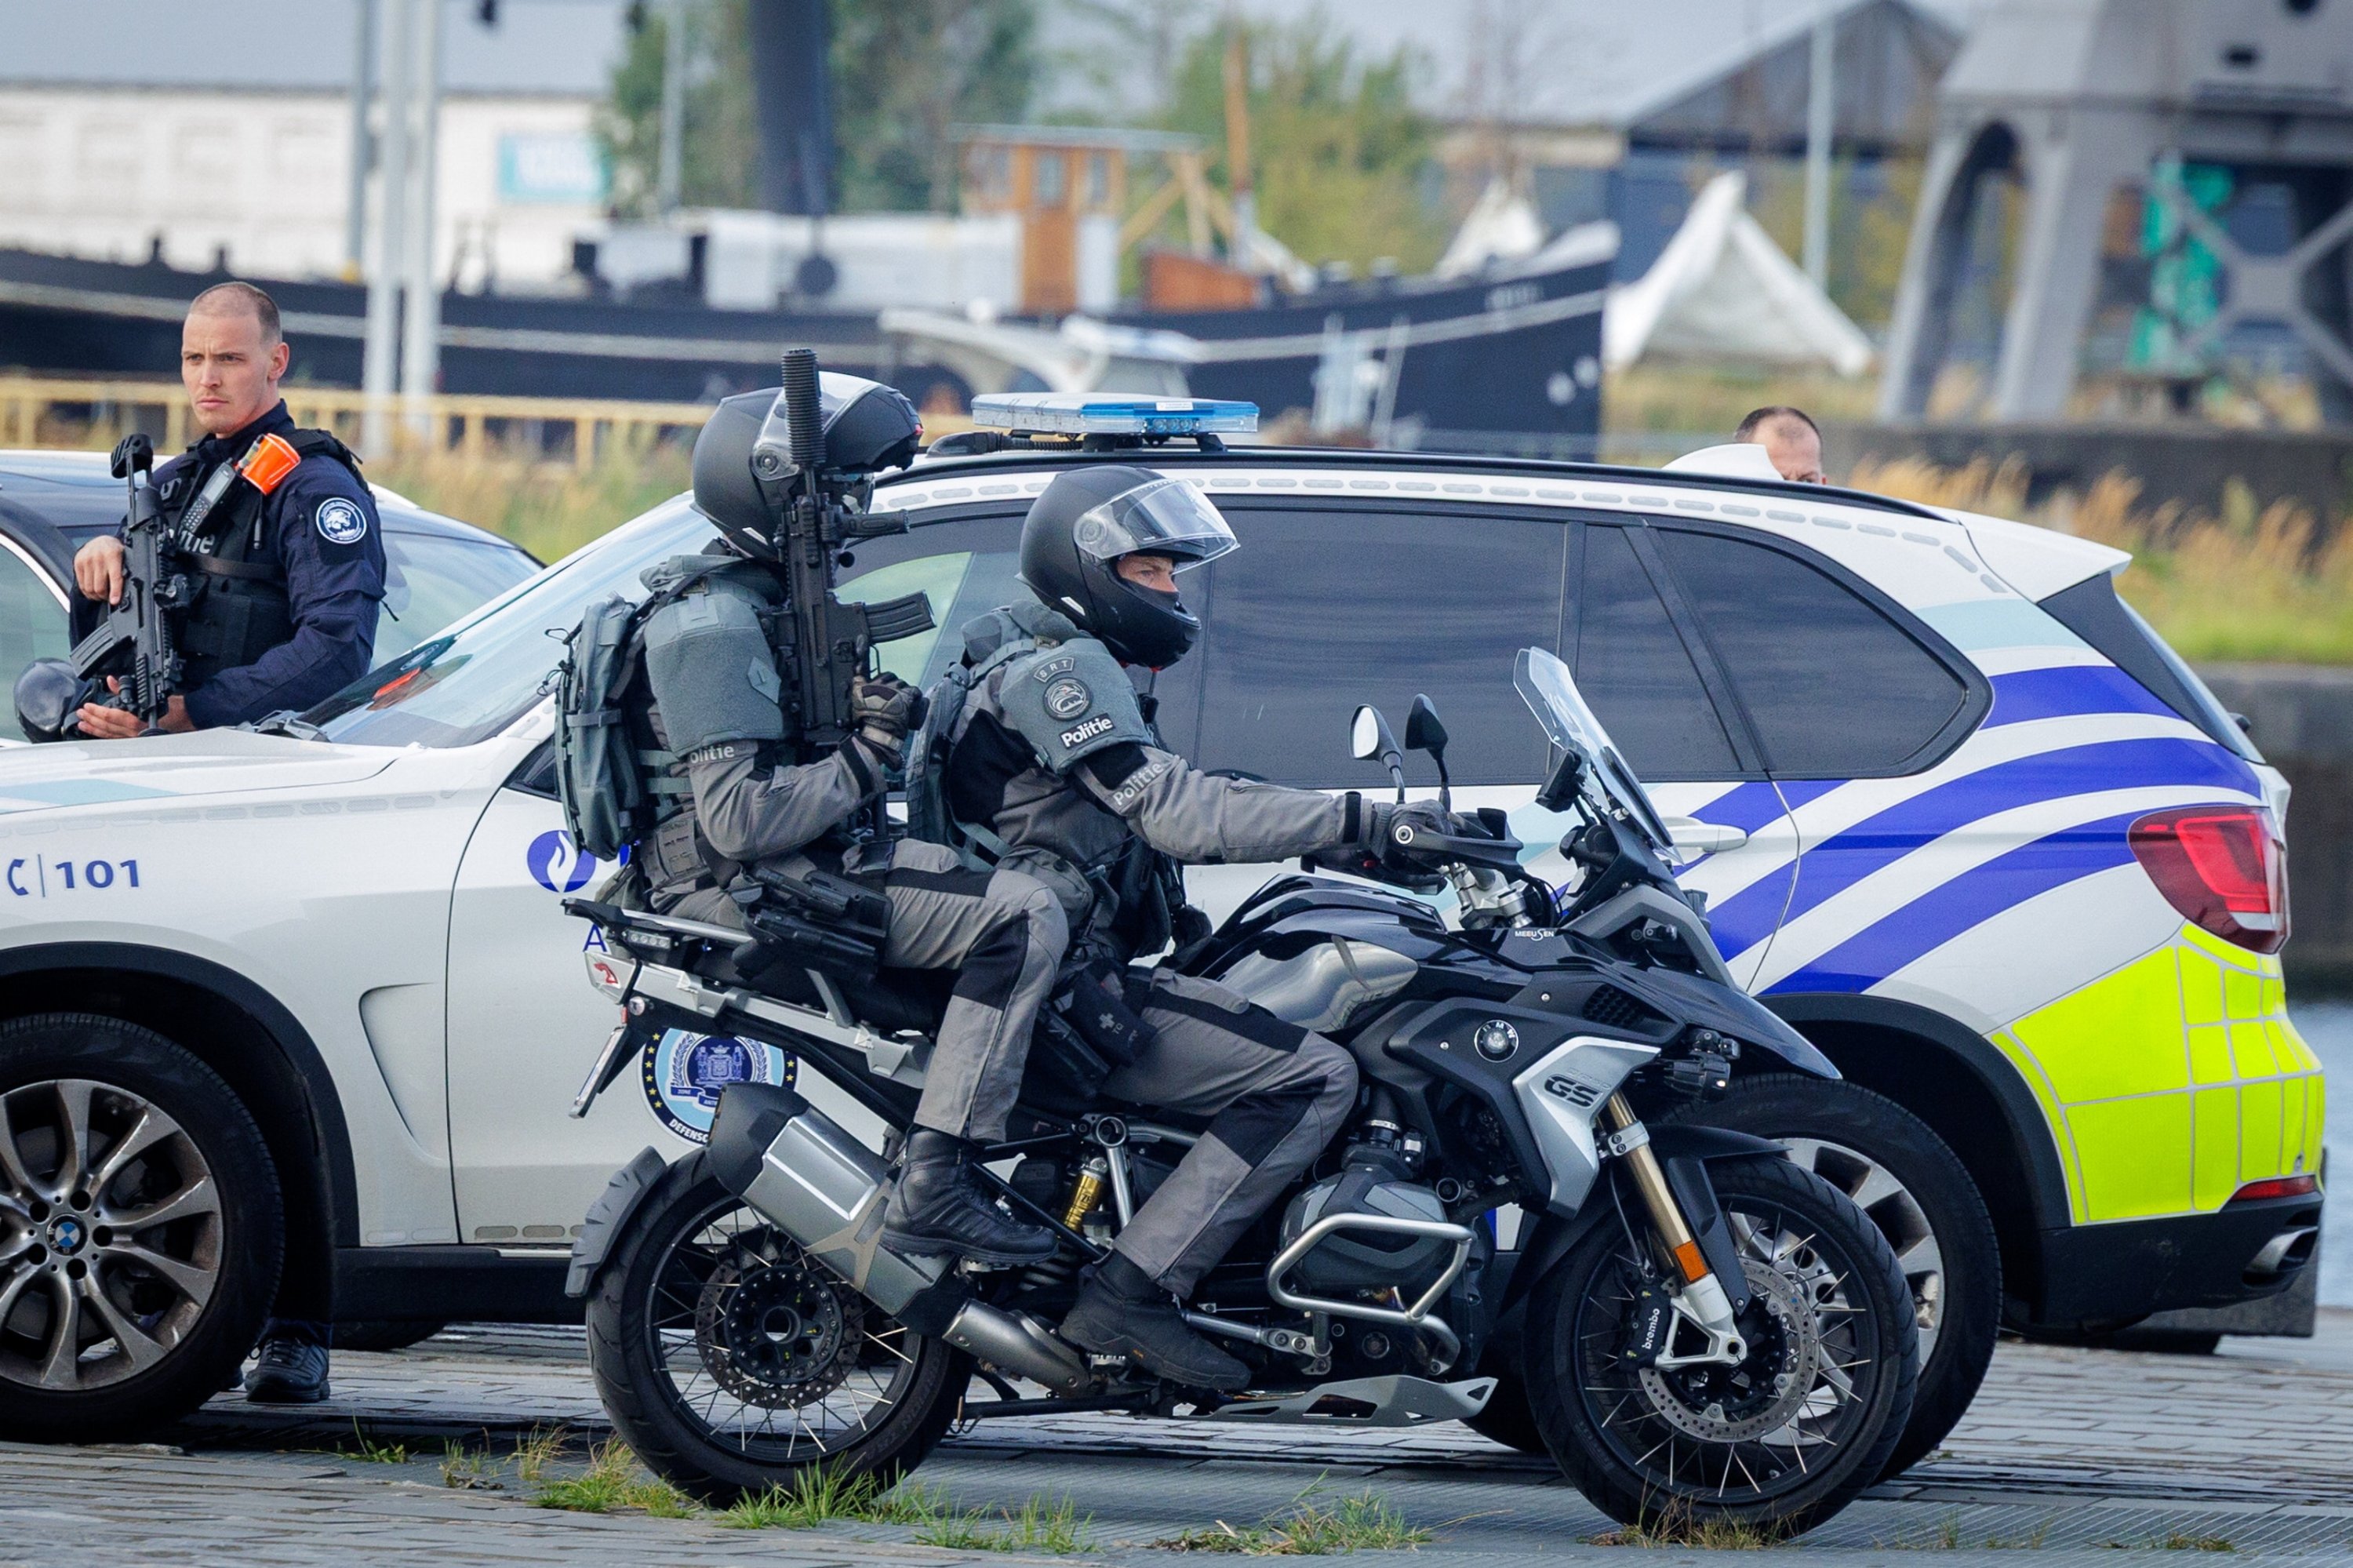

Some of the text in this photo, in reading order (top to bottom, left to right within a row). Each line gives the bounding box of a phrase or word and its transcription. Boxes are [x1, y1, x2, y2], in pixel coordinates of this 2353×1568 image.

[1060, 718, 1113, 748] Politie
[690, 744, 735, 764] olitie
[1113, 763, 1164, 806] Politie
[55, 860, 140, 889] 101
[1544, 1075, 1600, 1108] GS
[1642, 1308, 1660, 1349] brembo
